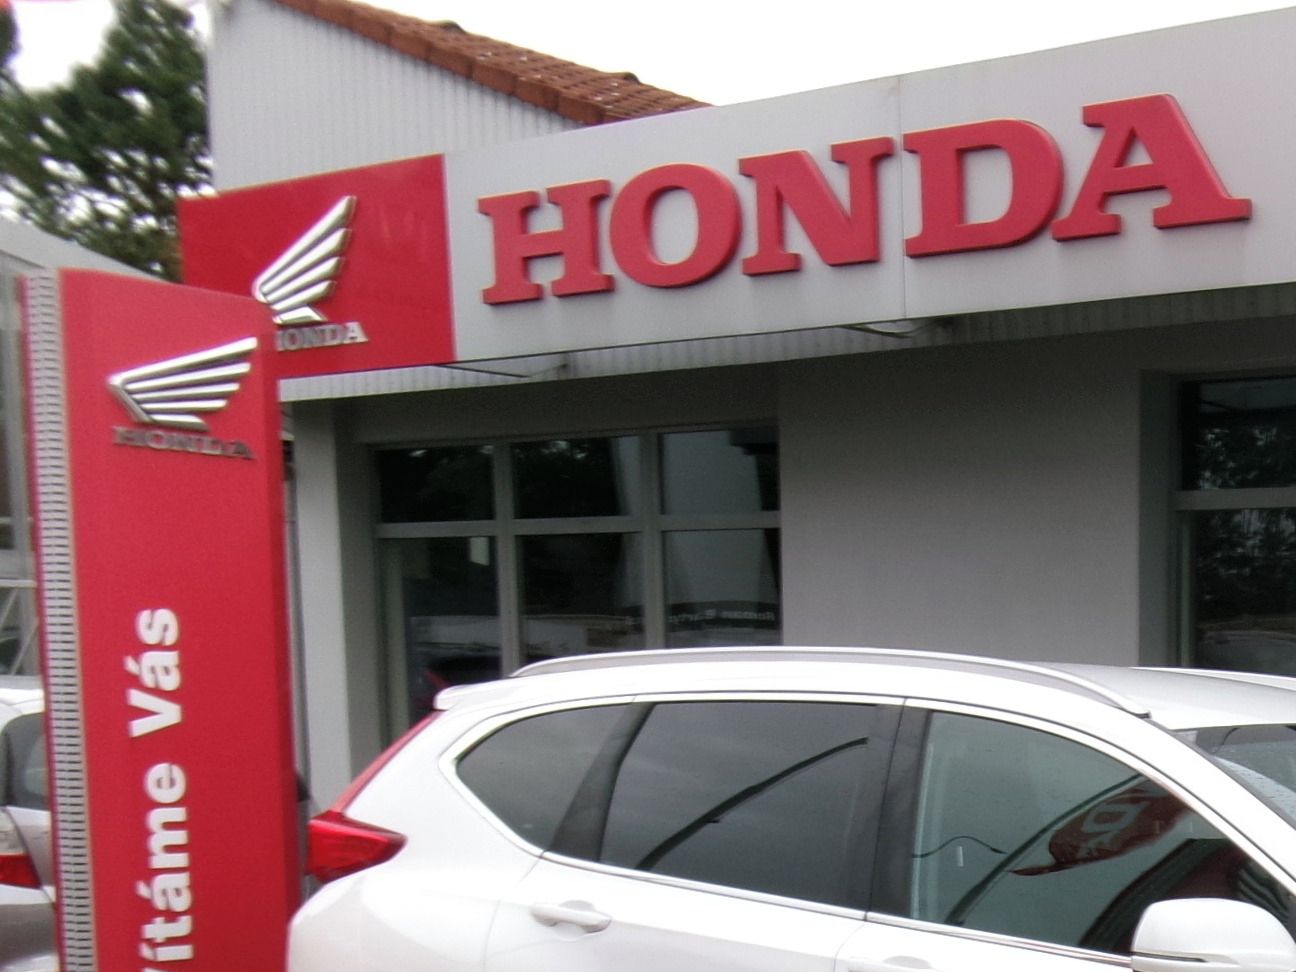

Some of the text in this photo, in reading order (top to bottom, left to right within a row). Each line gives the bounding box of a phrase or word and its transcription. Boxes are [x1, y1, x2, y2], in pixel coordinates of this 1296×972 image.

[477, 93, 1253, 306] HONDA
[112, 426, 256, 460] HONDA
[124, 607, 184, 738] Vás
